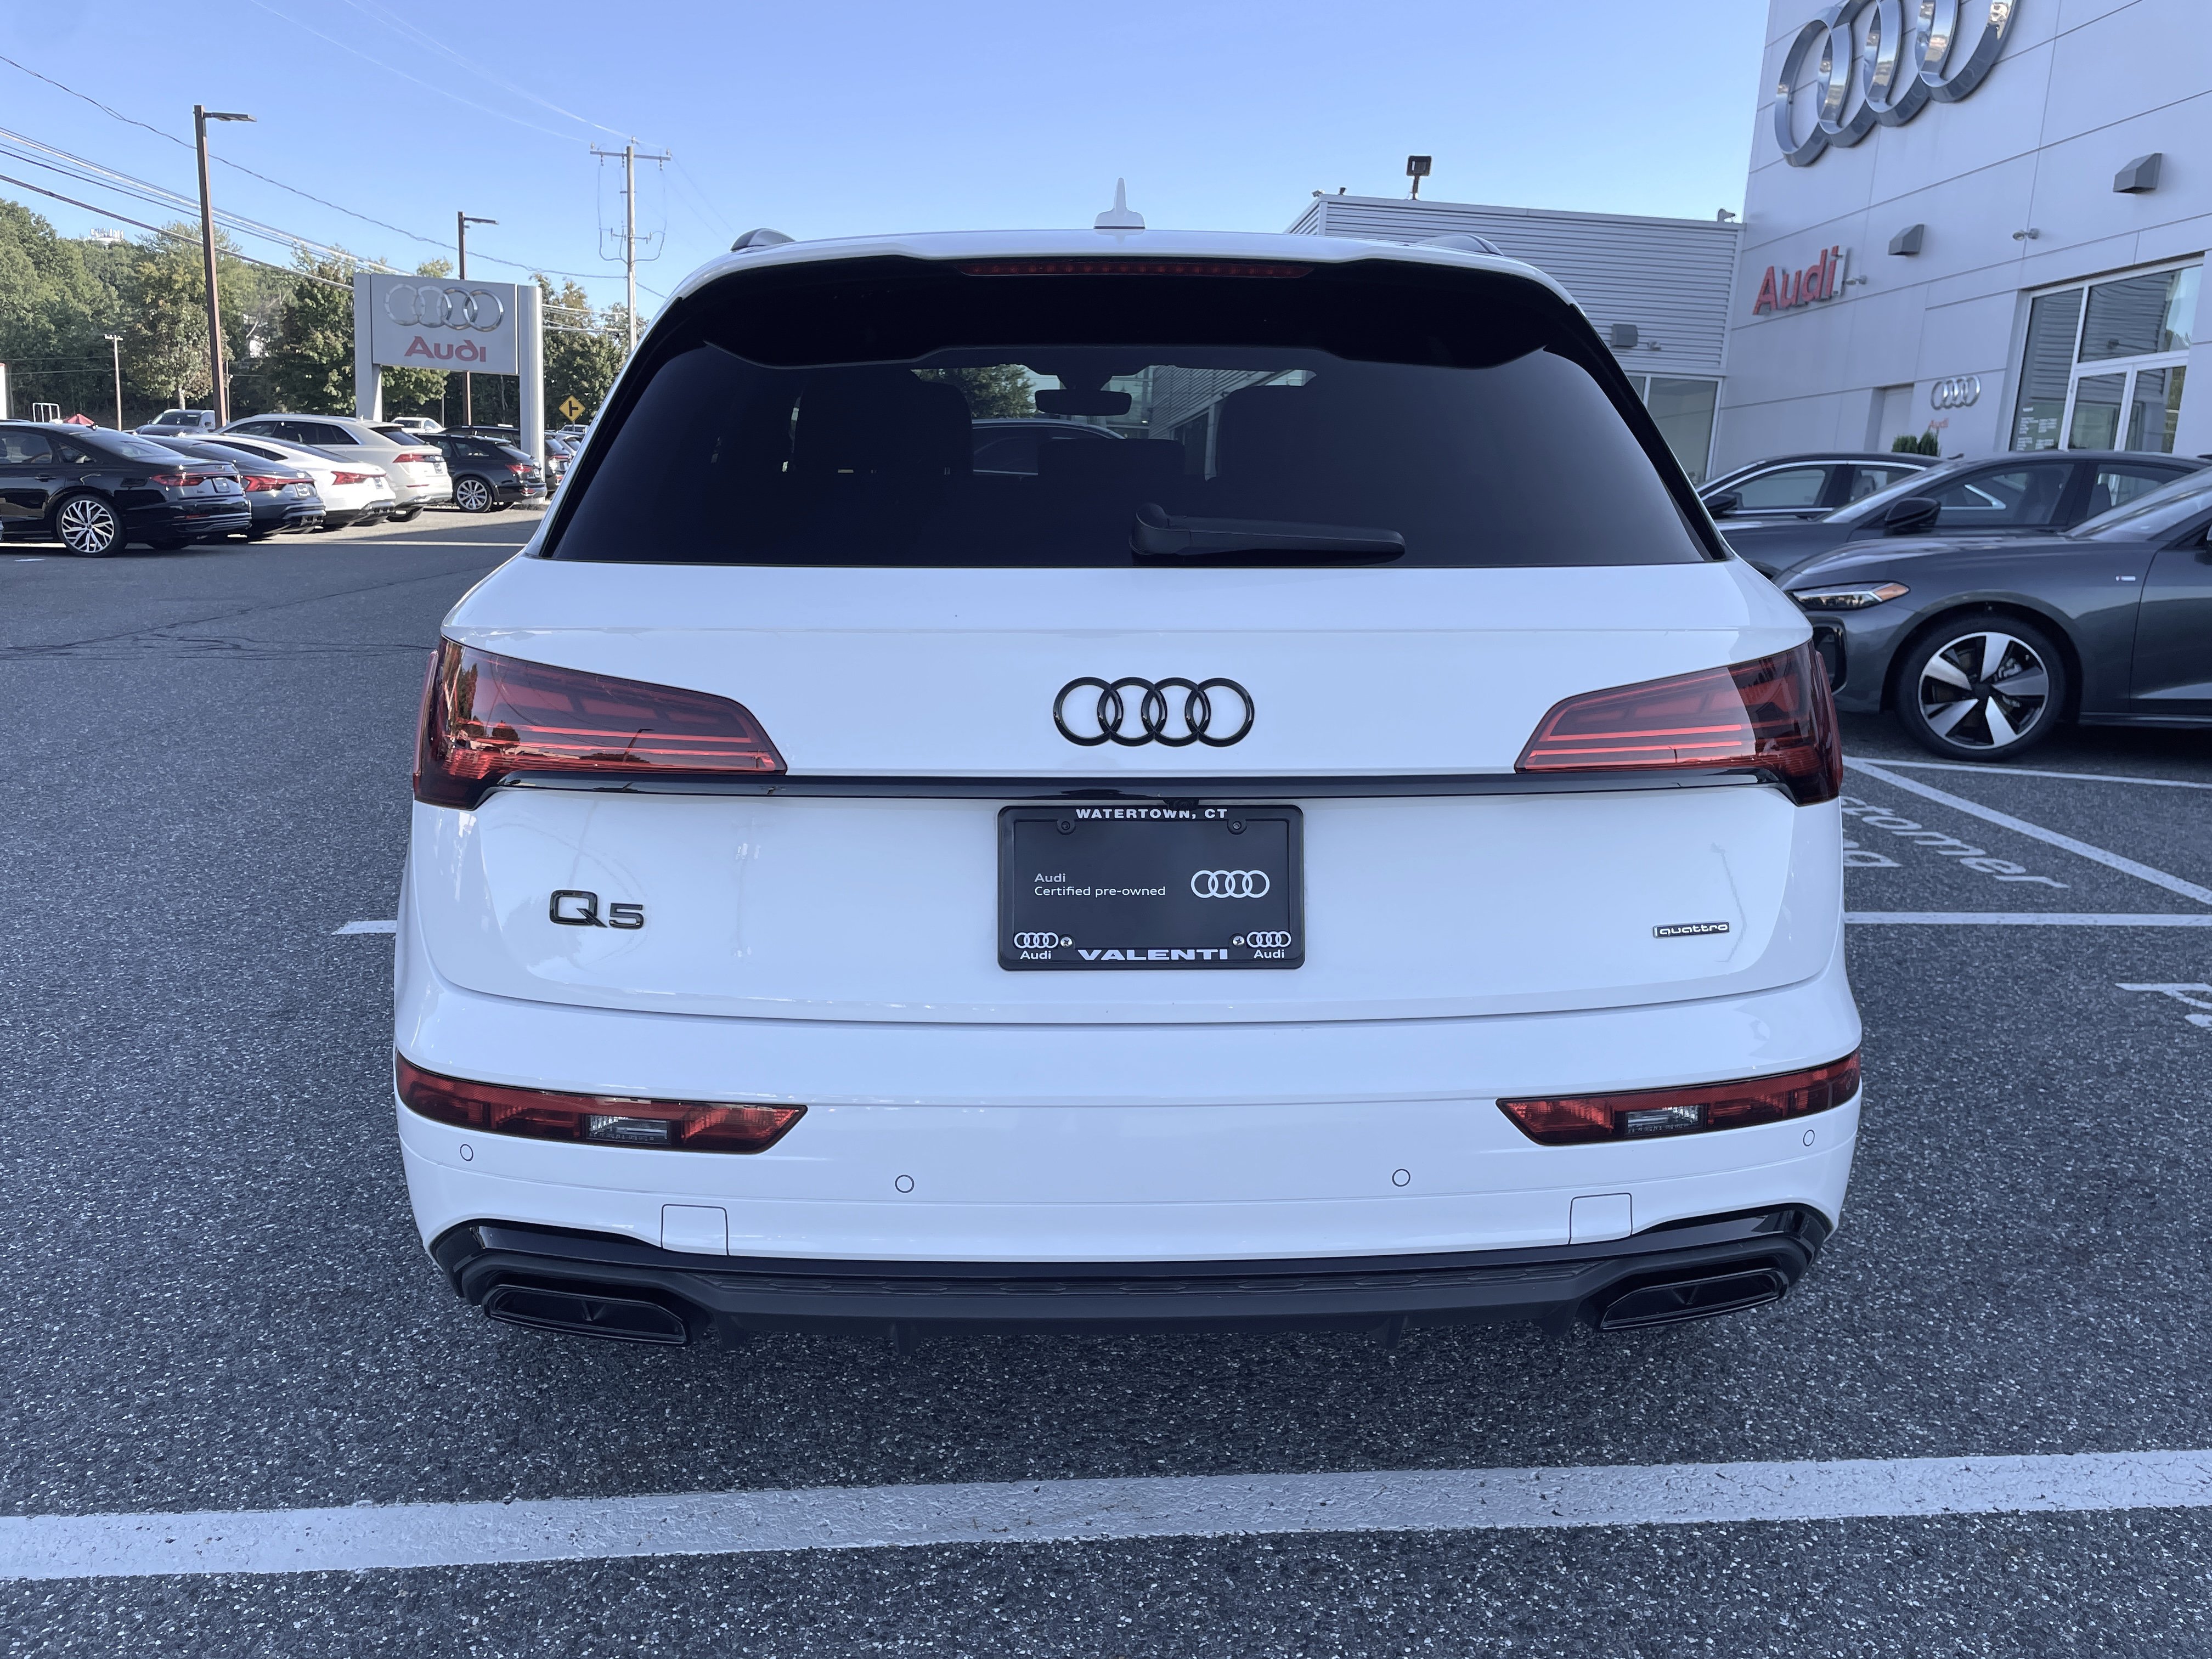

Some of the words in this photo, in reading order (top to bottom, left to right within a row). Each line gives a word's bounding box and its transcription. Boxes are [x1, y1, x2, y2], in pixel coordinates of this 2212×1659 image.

[1752, 245, 1839, 315] Audi
[404, 336, 487, 362] Audi
[1076, 809, 1196, 819] WATERTOWN,
[1204, 809, 1227, 819] CT
[1034, 873, 1066, 883] Audi
[1034, 886, 1091, 896] Certified
[1094, 886, 1166, 898] pre-owned
[549, 889, 645, 929] Q5
[1659, 924, 1728, 936] quattro
[1020, 950, 1052, 960] Audi
[1077, 949, 1228, 961] VALENTI
[1254, 949, 1285, 959] Audi
